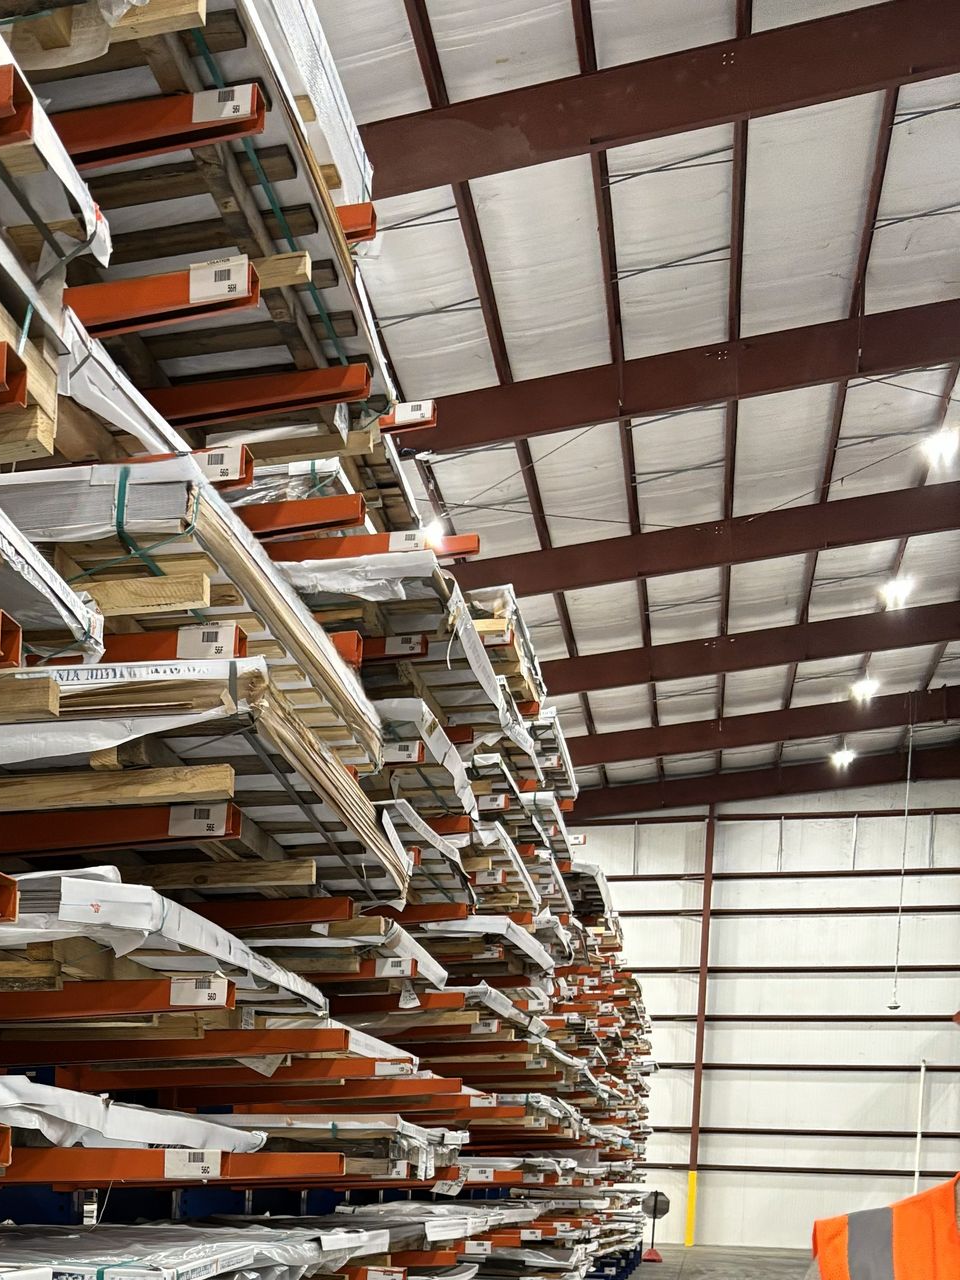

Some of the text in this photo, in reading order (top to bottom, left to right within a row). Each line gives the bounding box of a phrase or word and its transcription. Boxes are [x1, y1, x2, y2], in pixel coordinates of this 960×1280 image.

[227, 283, 237, 294] 56H
[214, 645, 224, 655] 56F
[206, 823, 215, 832] 56E
[207, 992, 217, 1001] 56D
